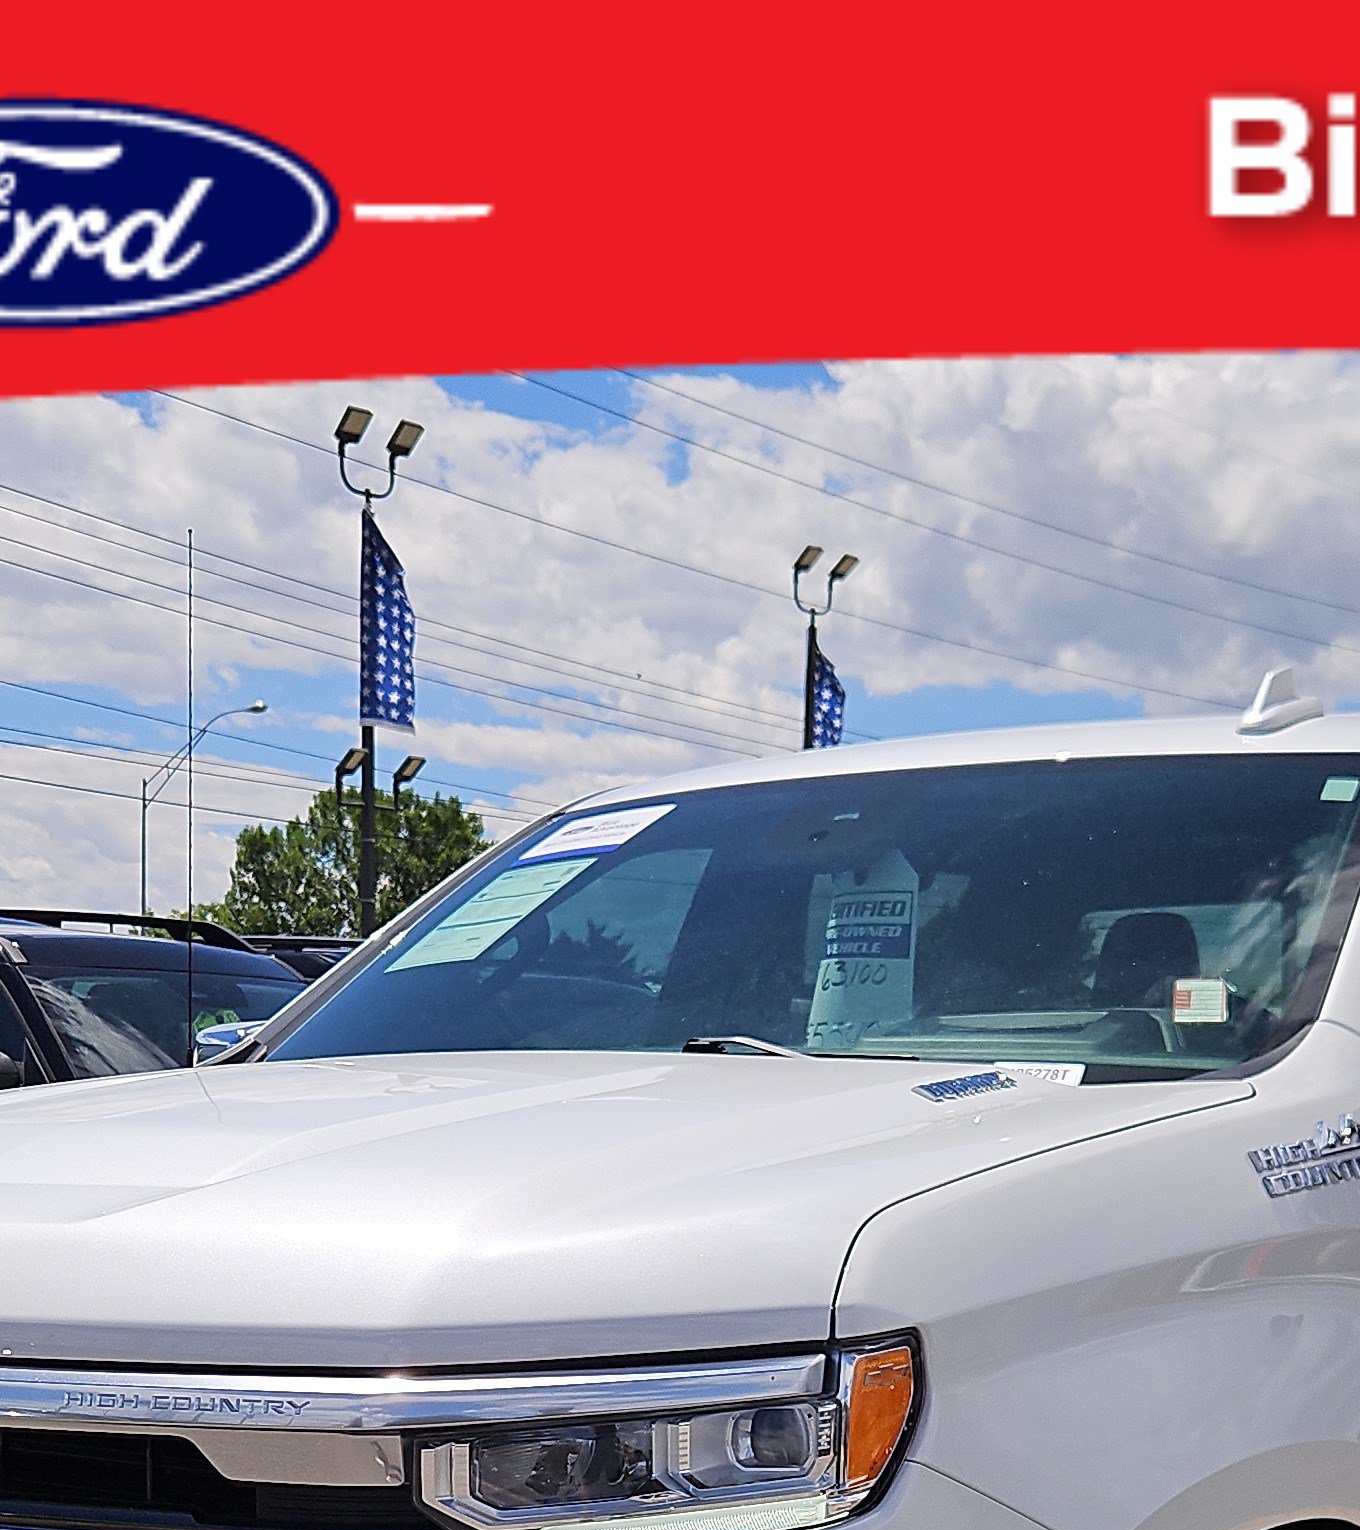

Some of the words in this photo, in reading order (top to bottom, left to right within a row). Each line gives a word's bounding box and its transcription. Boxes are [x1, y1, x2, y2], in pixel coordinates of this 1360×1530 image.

[1011, 1068, 1071, 1081] 5278T
[63, 1391, 139, 1409] HIGH
[151, 1394, 311, 1416] COUNTRY
